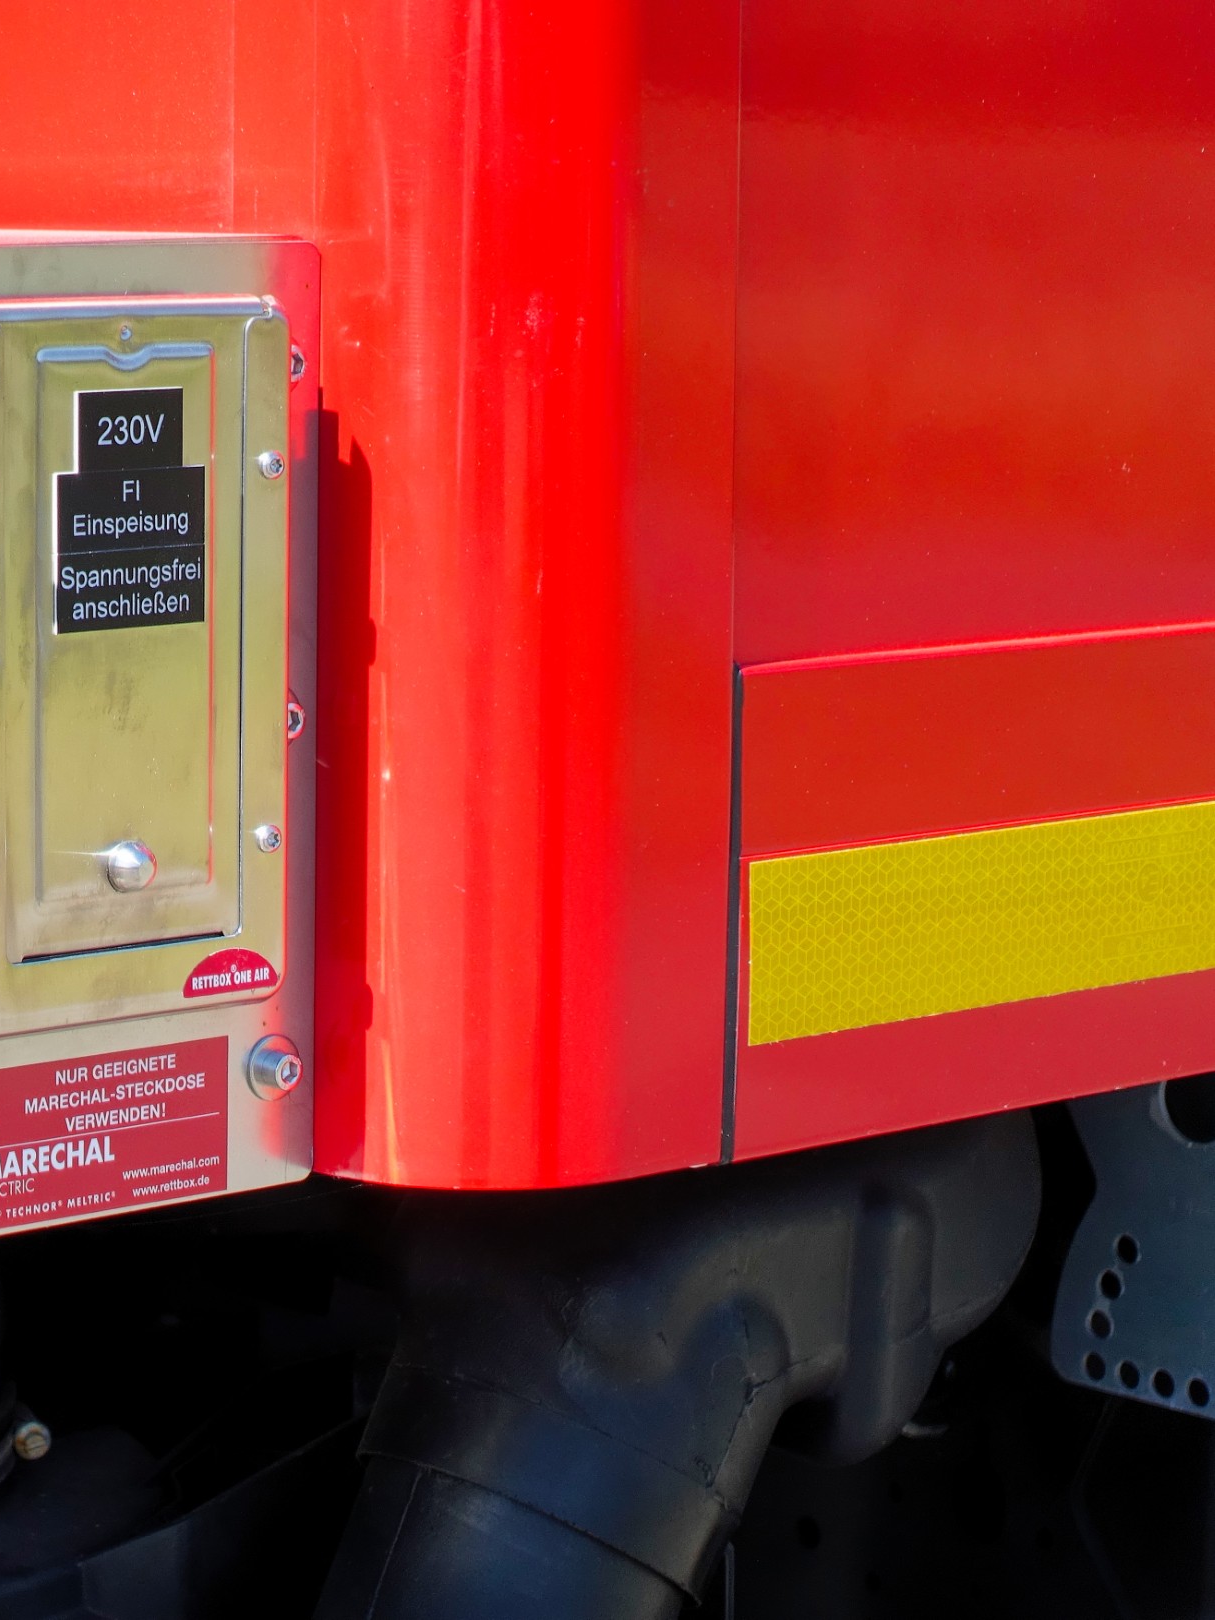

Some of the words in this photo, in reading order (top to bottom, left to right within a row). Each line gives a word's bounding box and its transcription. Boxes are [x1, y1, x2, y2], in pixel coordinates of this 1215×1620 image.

[98, 414, 165, 446] 230V
[122, 480, 141, 502] FI
[73, 510, 189, 539] Einspeisung
[61, 557, 202, 594] Spannungsfrei
[72, 590, 190, 620] anschließen
[234, 969, 252, 985] ONE
[254, 967, 270, 982] AIR
[55, 1067, 88, 1086] NUR
[92, 1053, 177, 1081] GEEIGNETE
[24, 1072, 206, 1115] MARECHAL-STECKDOSE
[65, 1102, 167, 1132] VERWENDEN!
[122, 1155, 220, 1180] www.marechal.com
[132, 1174, 210, 1198] www.rettbox.de
